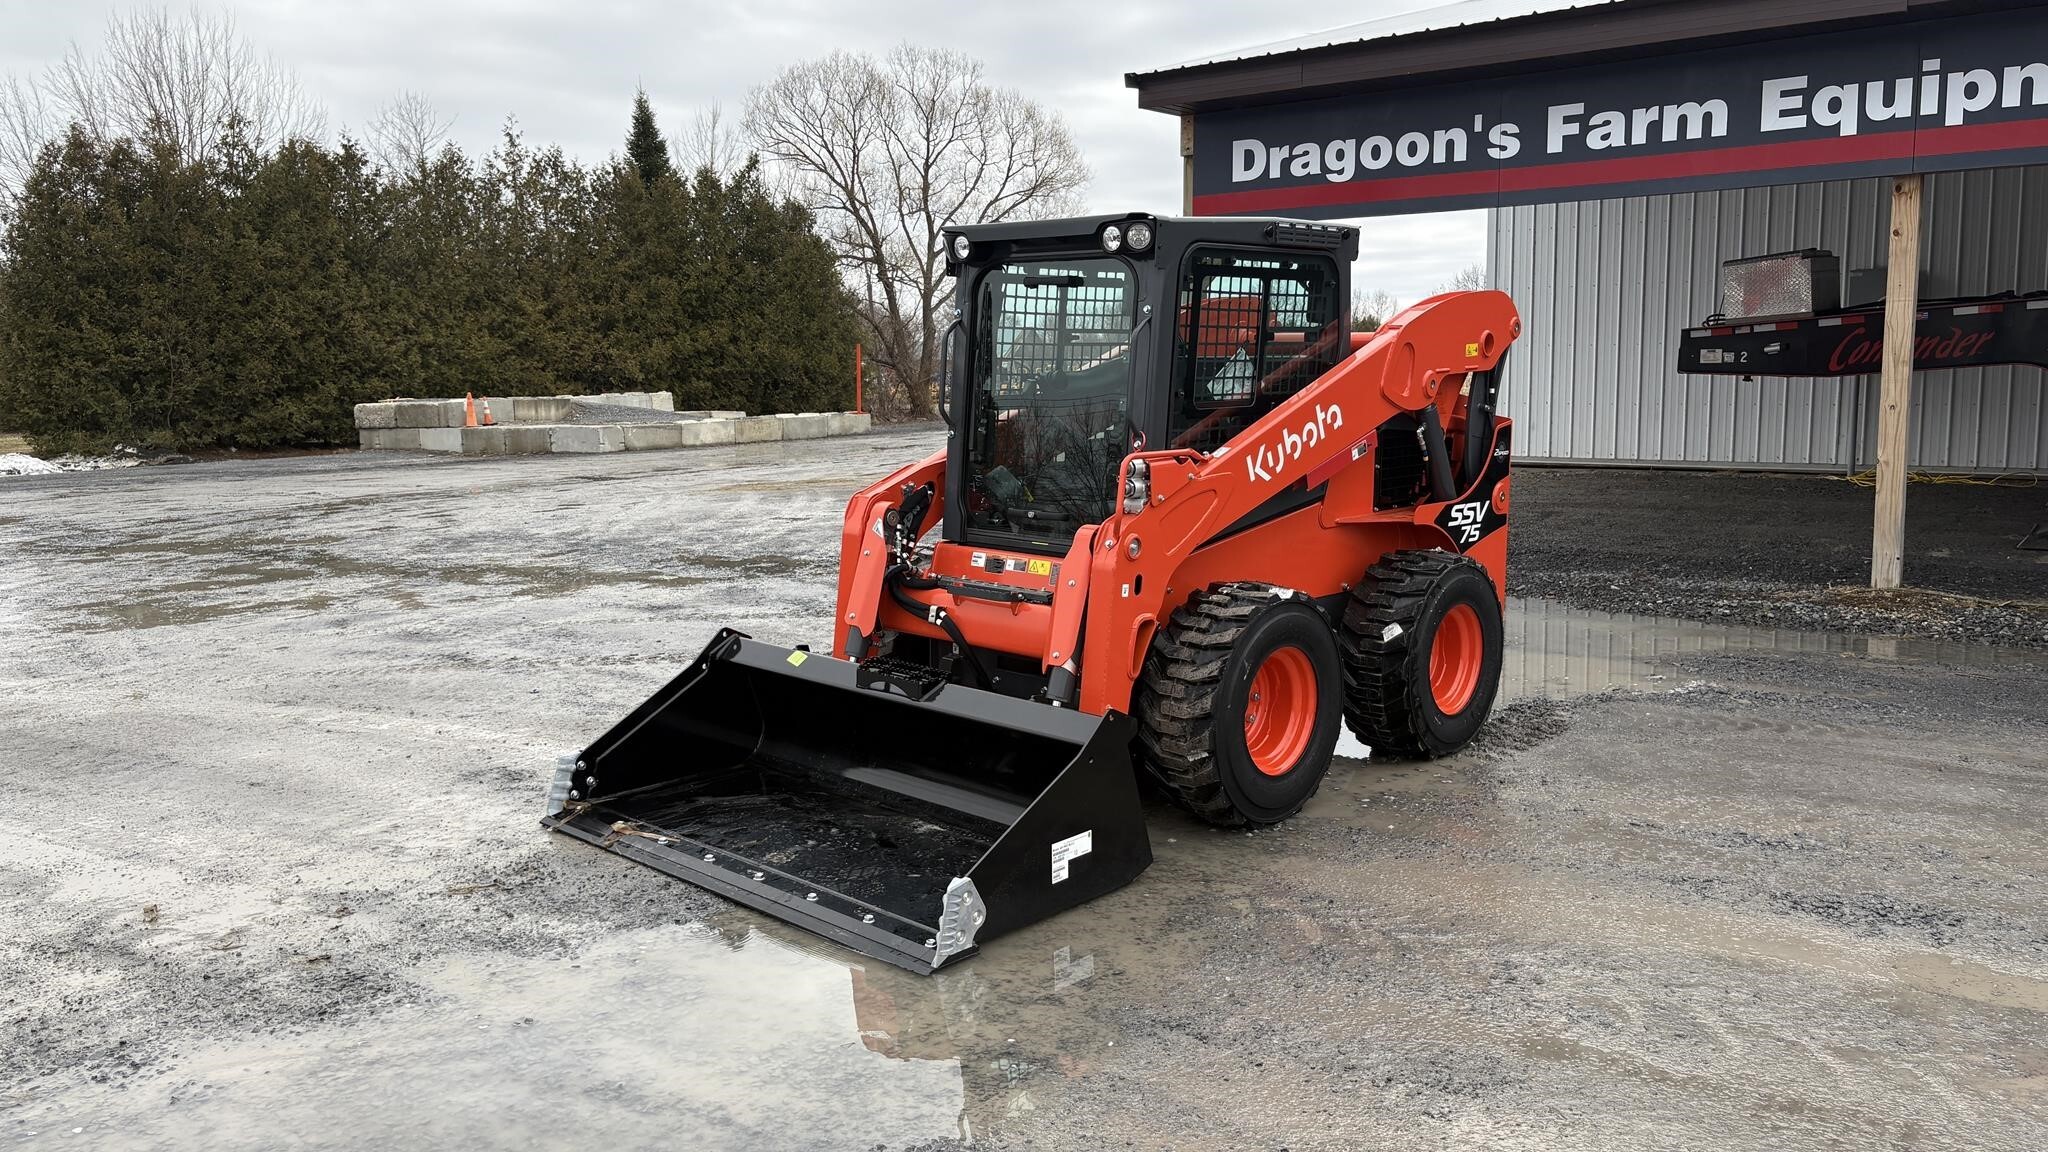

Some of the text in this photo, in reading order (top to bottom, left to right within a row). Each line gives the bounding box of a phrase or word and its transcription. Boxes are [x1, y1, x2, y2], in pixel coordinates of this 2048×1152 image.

[1232, 113, 1521, 183] Dragoon's
[1546, 98, 1729, 154] Farm
[1740, 351, 1749, 363] 2
[1246, 403, 1343, 482] Kubota
[1447, 500, 1491, 527] SSV
[1460, 523, 1482, 544] 75
